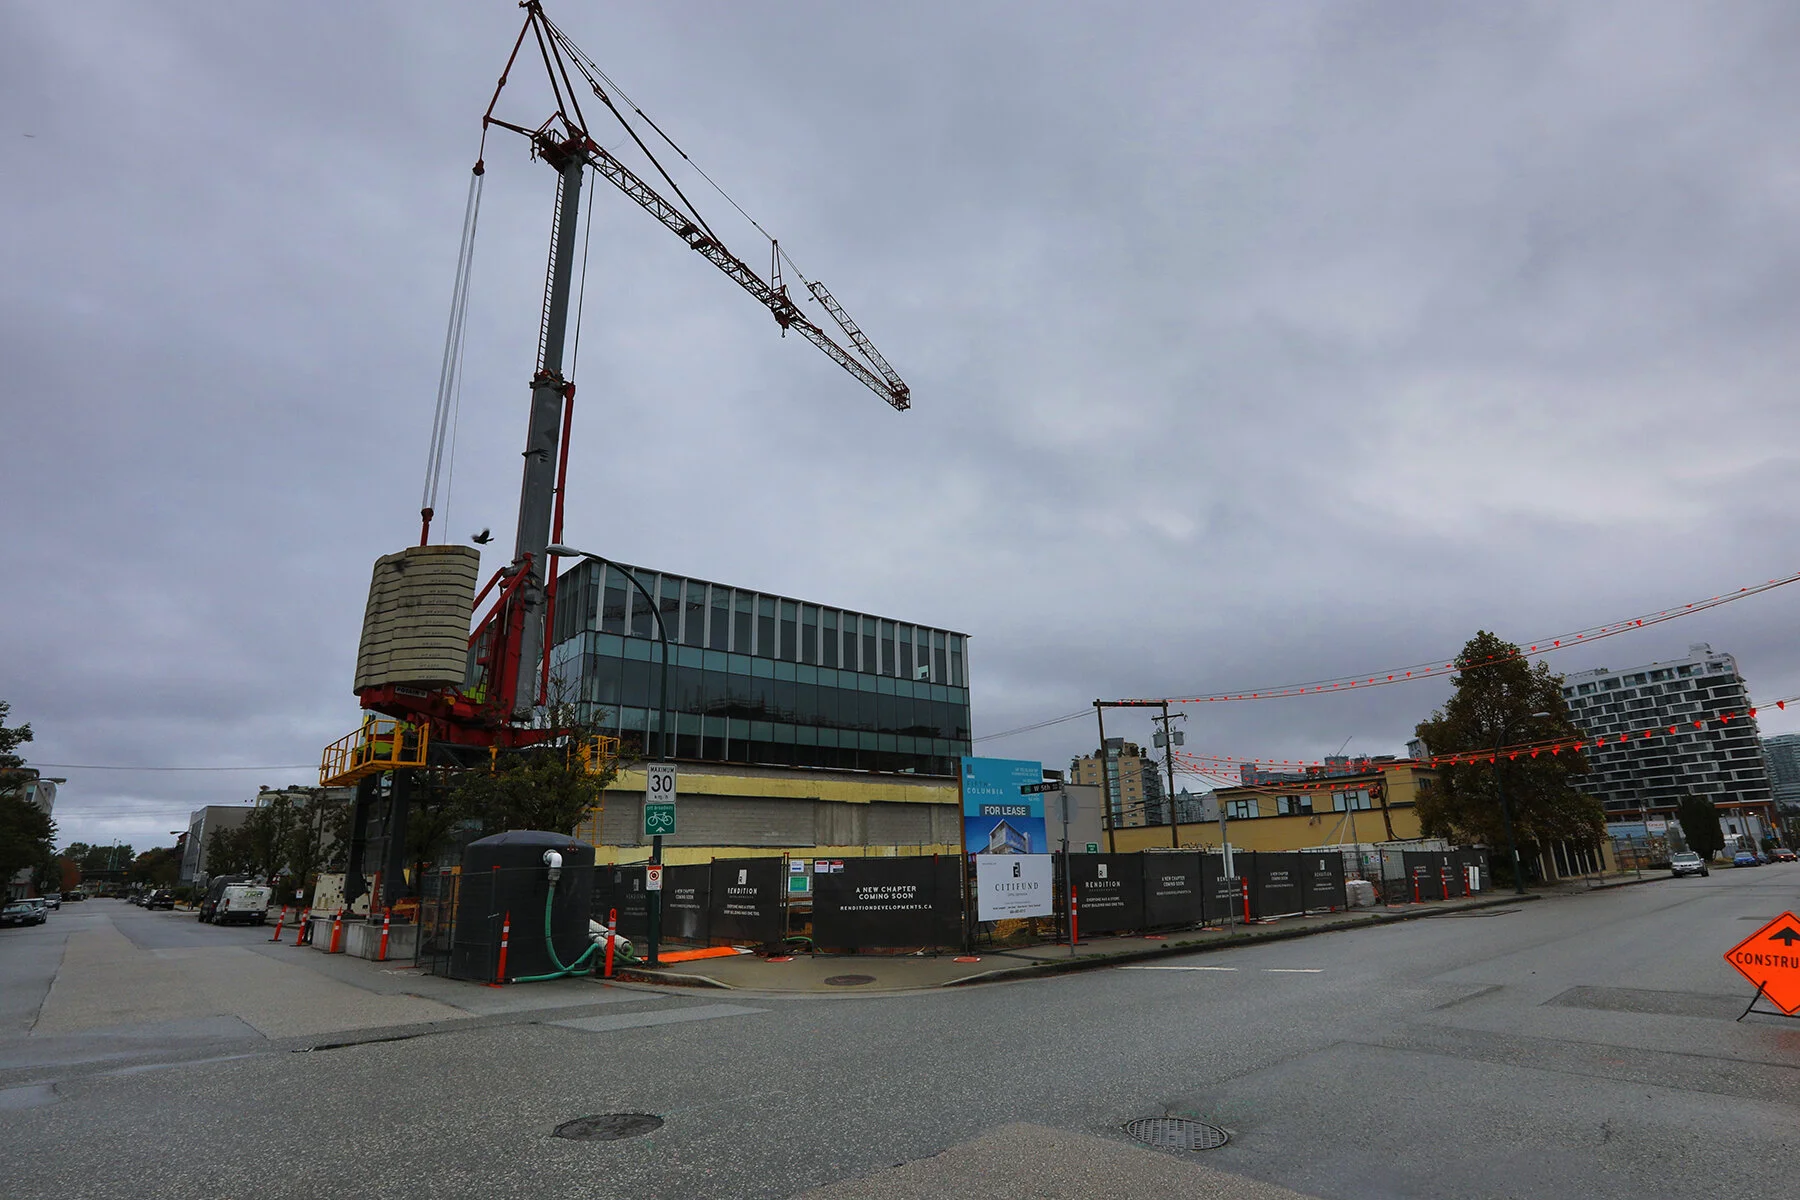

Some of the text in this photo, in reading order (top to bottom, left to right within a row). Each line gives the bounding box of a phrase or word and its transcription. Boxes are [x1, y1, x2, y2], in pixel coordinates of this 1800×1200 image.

[651, 774, 672, 793] 30
[1040, 784, 1051, 792] 5th
[984, 805, 1026, 816] FOR LEASE
[881, 885, 917, 893] CHAPTER
[994, 882, 1039, 892] CITIFUND
[1735, 951, 1799, 969] CONSTRU
